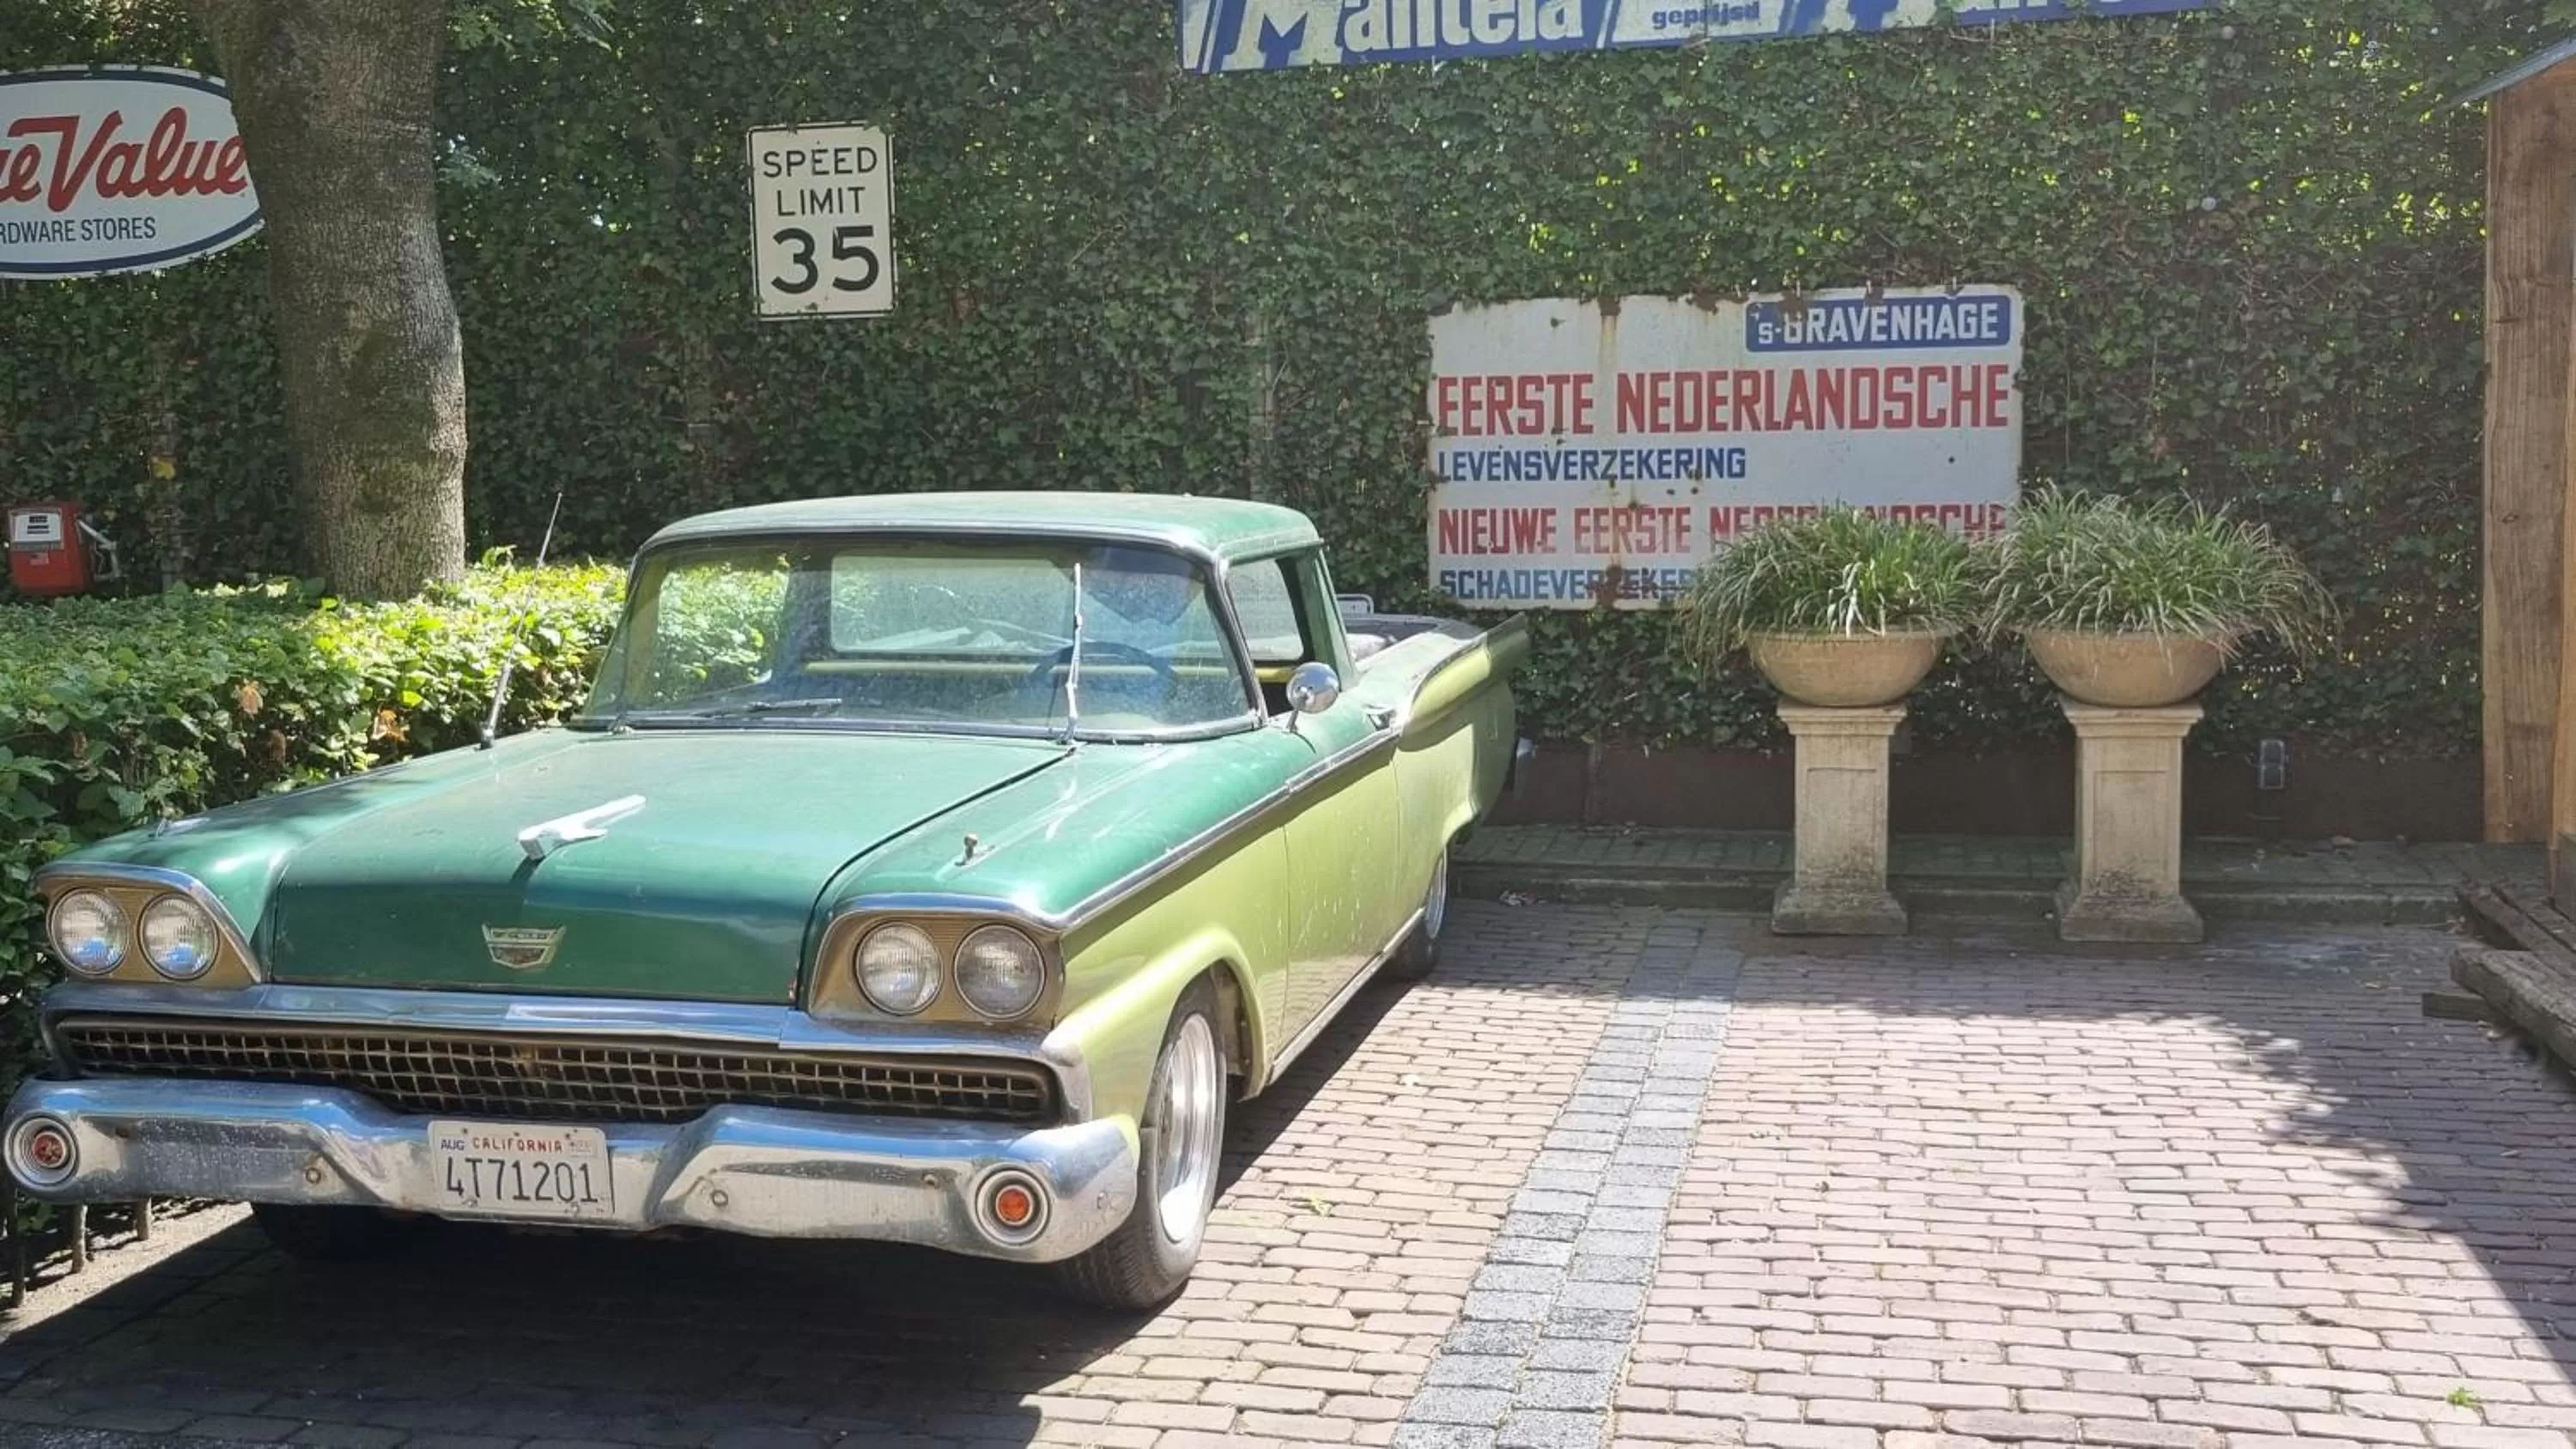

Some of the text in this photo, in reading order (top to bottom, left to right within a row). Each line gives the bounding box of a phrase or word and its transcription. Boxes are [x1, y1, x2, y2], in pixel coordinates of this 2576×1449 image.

[8, 106, 248, 212] Value
[763, 147, 877, 178] SPEED
[777, 186, 866, 216] LIMIT
[82, 217, 155, 240] STORES
[771, 225, 879, 294] 35
[1437, 365, 2008, 436] EERSTE NEDERLANDSCHE
[1438, 447, 1746, 482] LEVENSVERZEKERING
[1439, 508, 1557, 555] NIEUWE
[1574, 507, 1691, 554] EERSTE
[441, 1139, 465, 1150] AUG
[473, 1137, 562, 1153] CALIFORNIA
[447, 1157, 598, 1203] 4T71201
